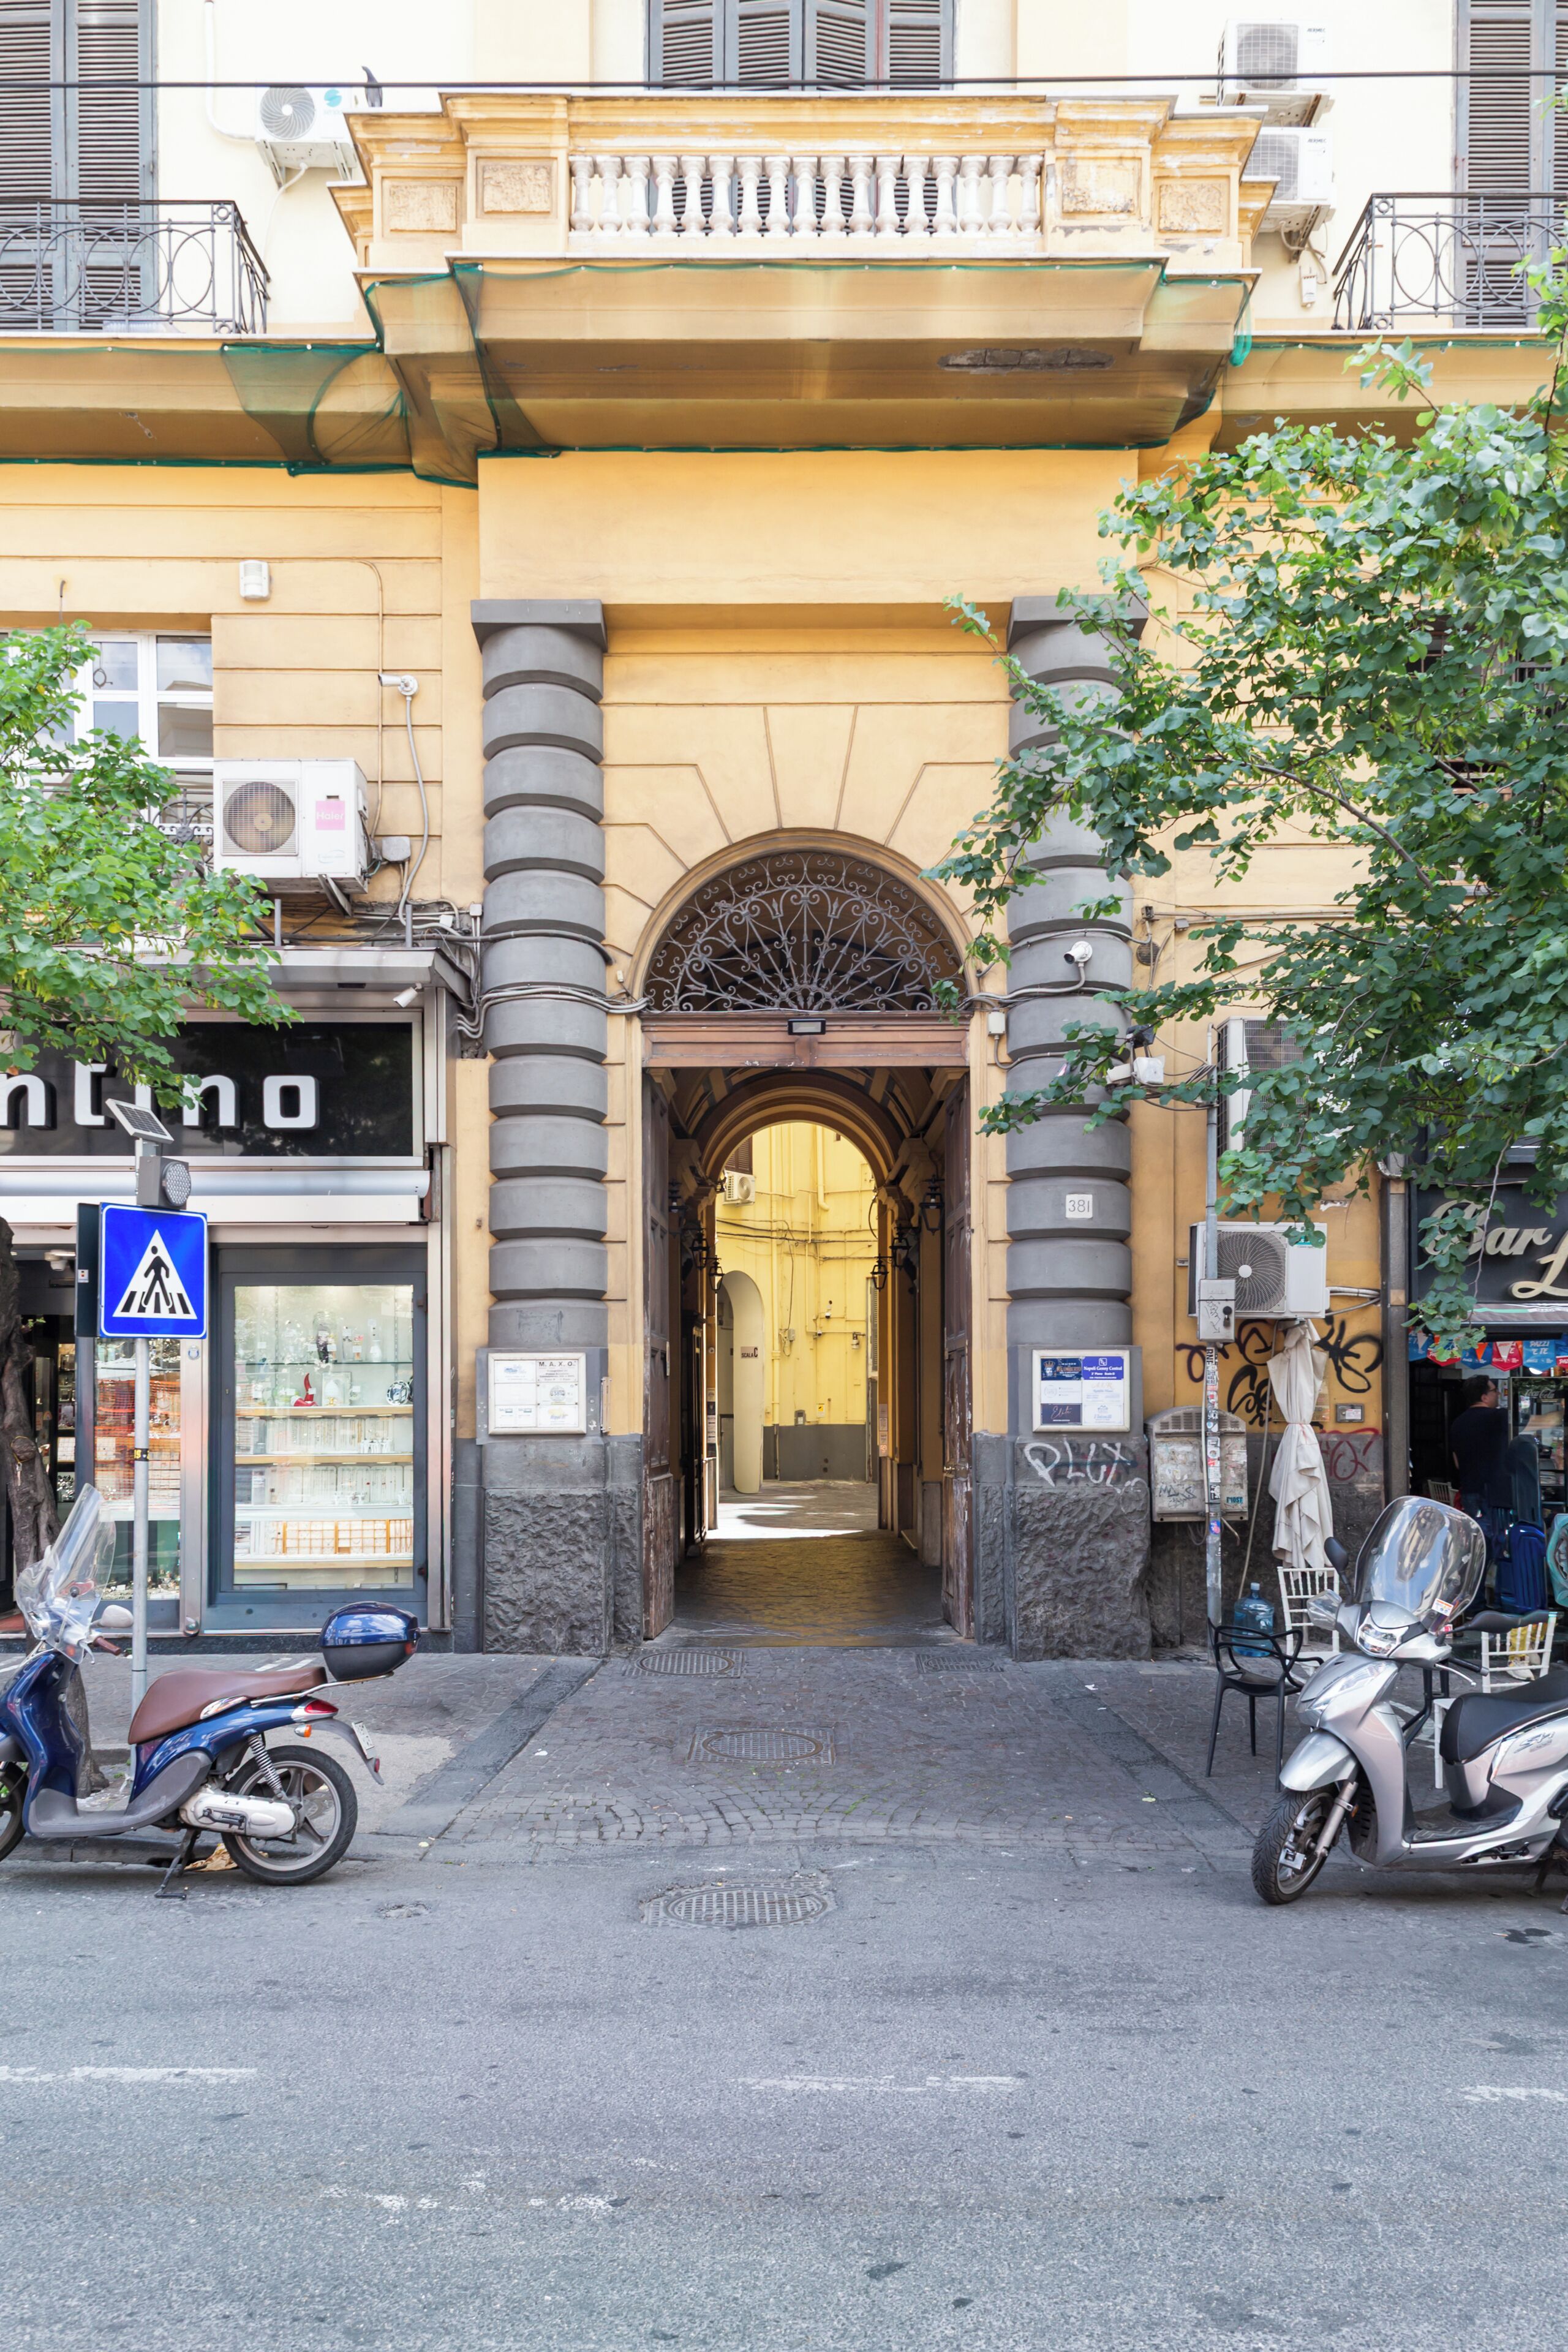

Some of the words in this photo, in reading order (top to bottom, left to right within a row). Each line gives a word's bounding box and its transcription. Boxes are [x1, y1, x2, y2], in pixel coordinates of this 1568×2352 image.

[317, 810, 344, 820] Haier
[1068, 1199, 1090, 1213] 381
[753, 1347, 758, 1358] C
